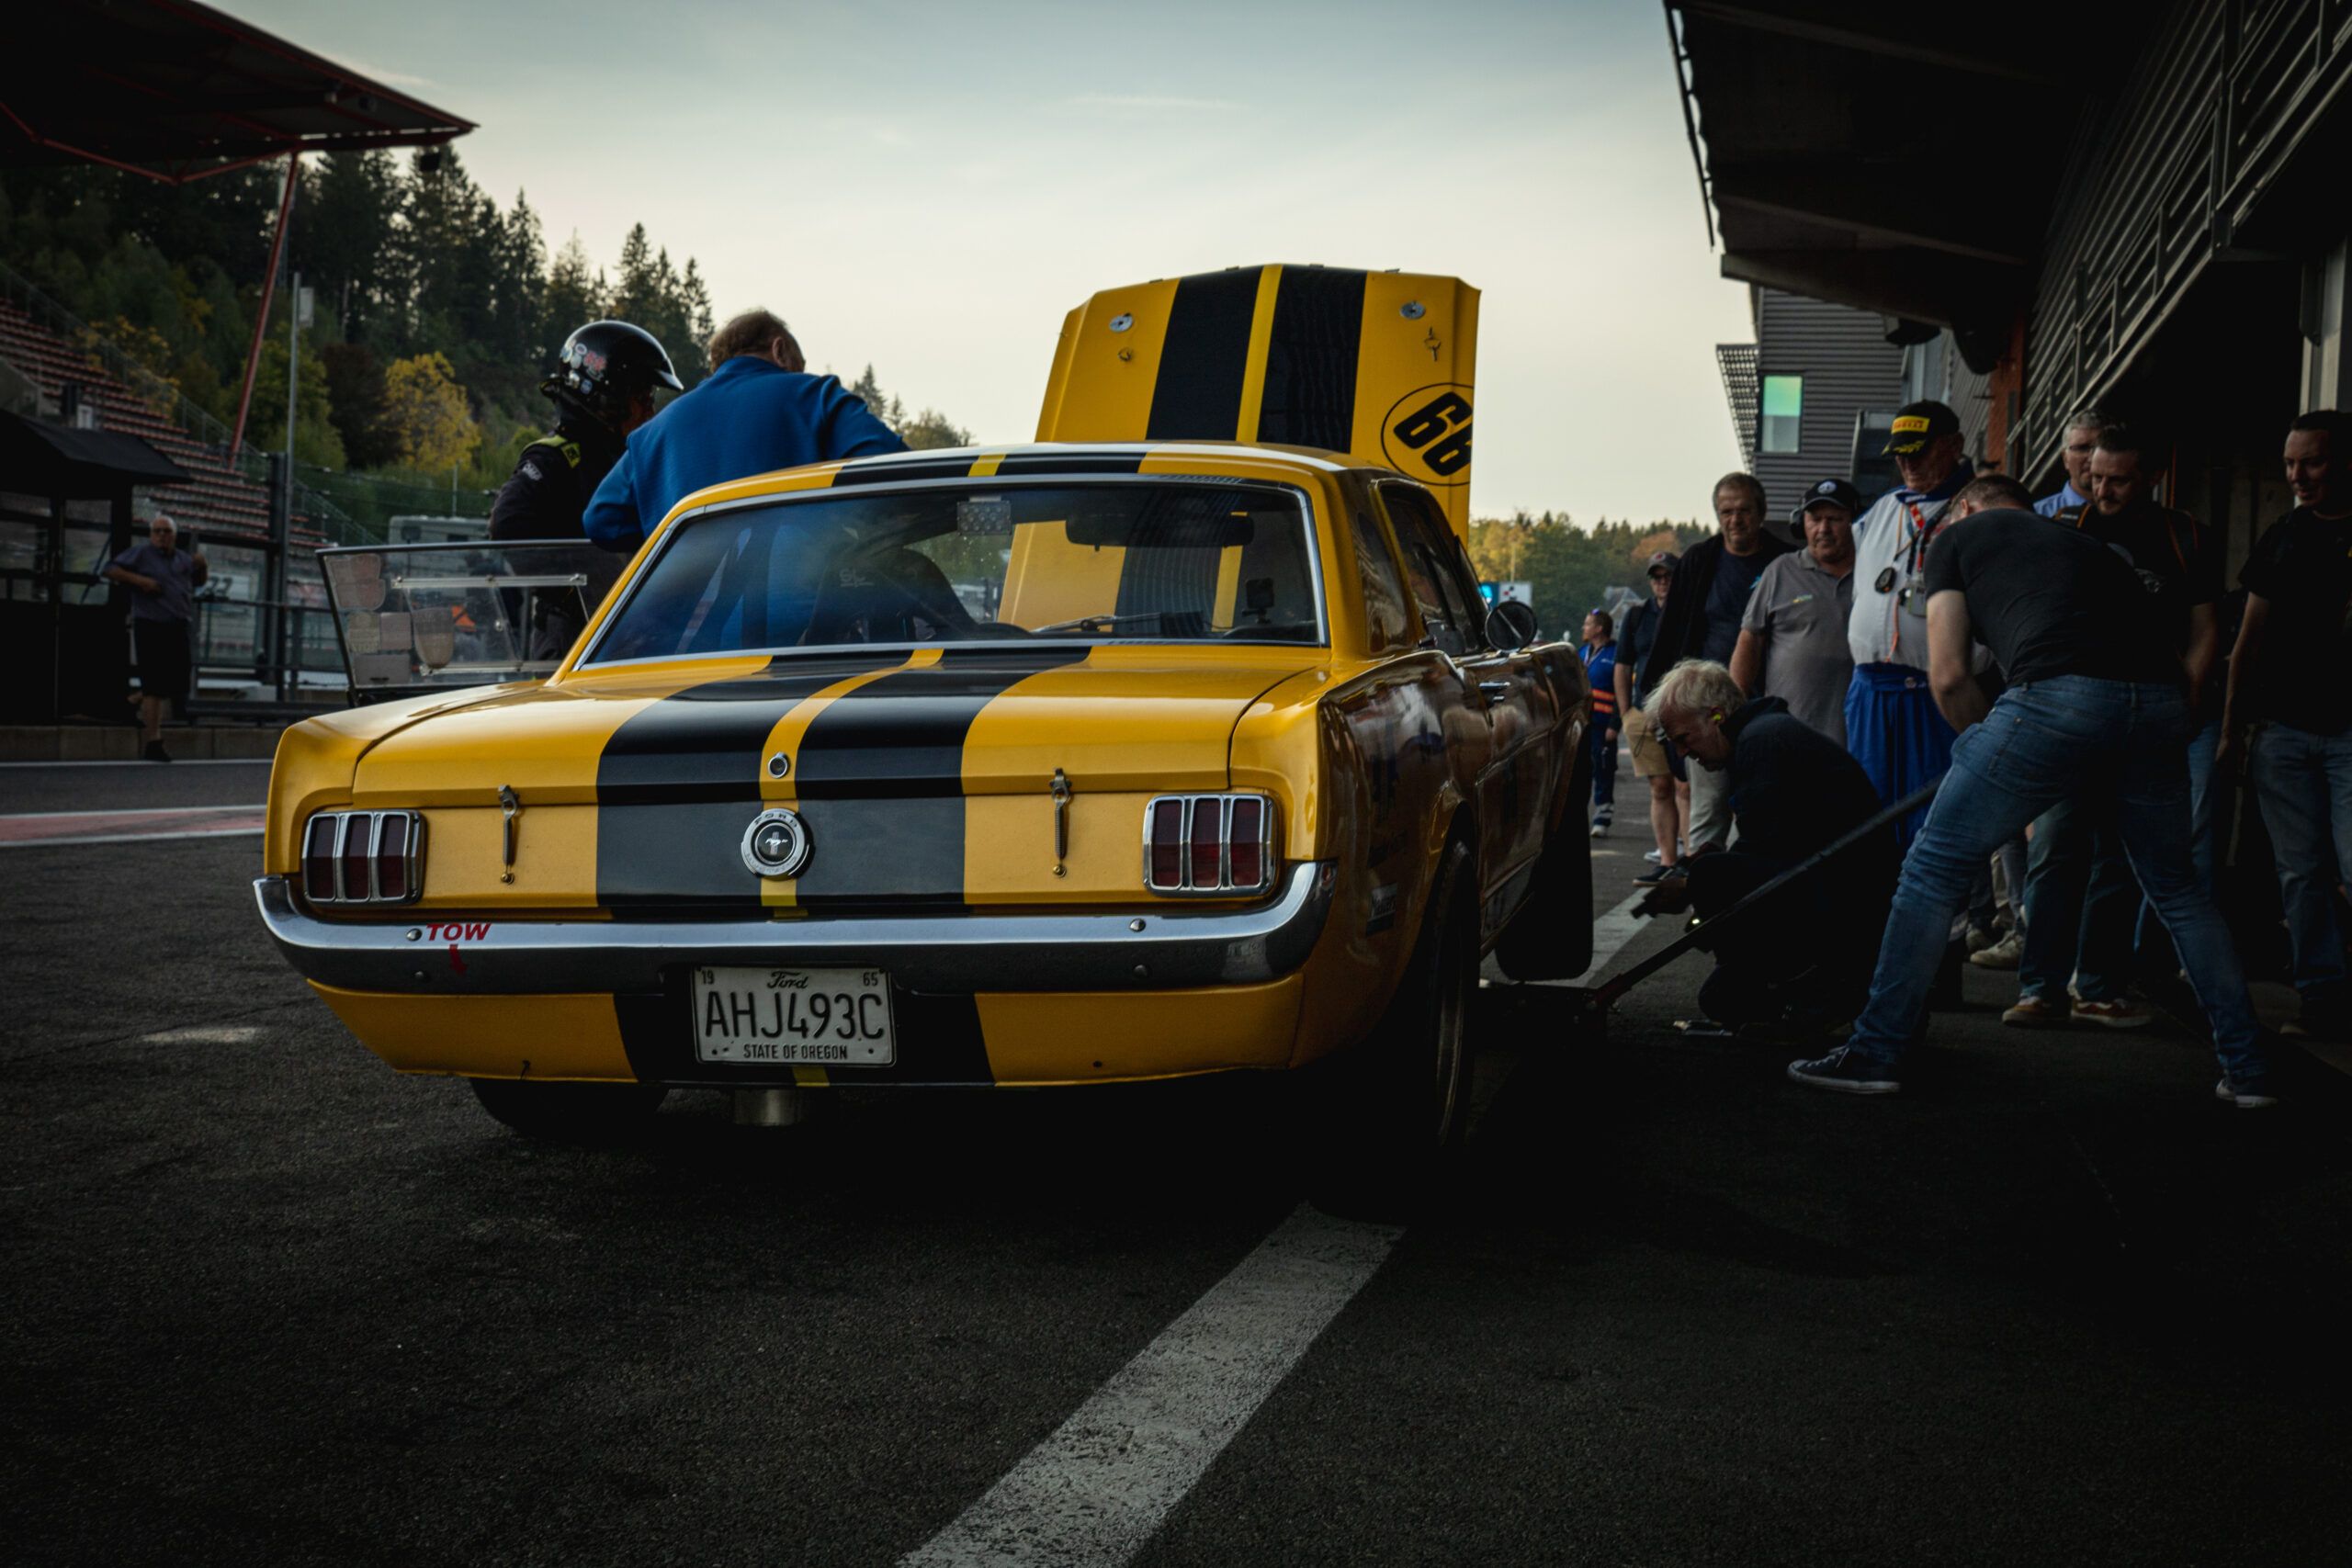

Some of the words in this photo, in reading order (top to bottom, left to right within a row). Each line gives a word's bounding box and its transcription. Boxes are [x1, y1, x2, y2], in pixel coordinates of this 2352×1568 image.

[1393, 391, 1473, 476] 66
[425, 922, 492, 942] TOW
[701, 970, 715, 985] 19
[767, 970, 809, 989] Ford
[863, 972, 878, 987] 65
[705, 990, 885, 1040] AHJ493C
[743, 1043, 778, 1059] STATE
[783, 1044, 797, 1059] OF
[801, 1044, 848, 1060] OREGON
